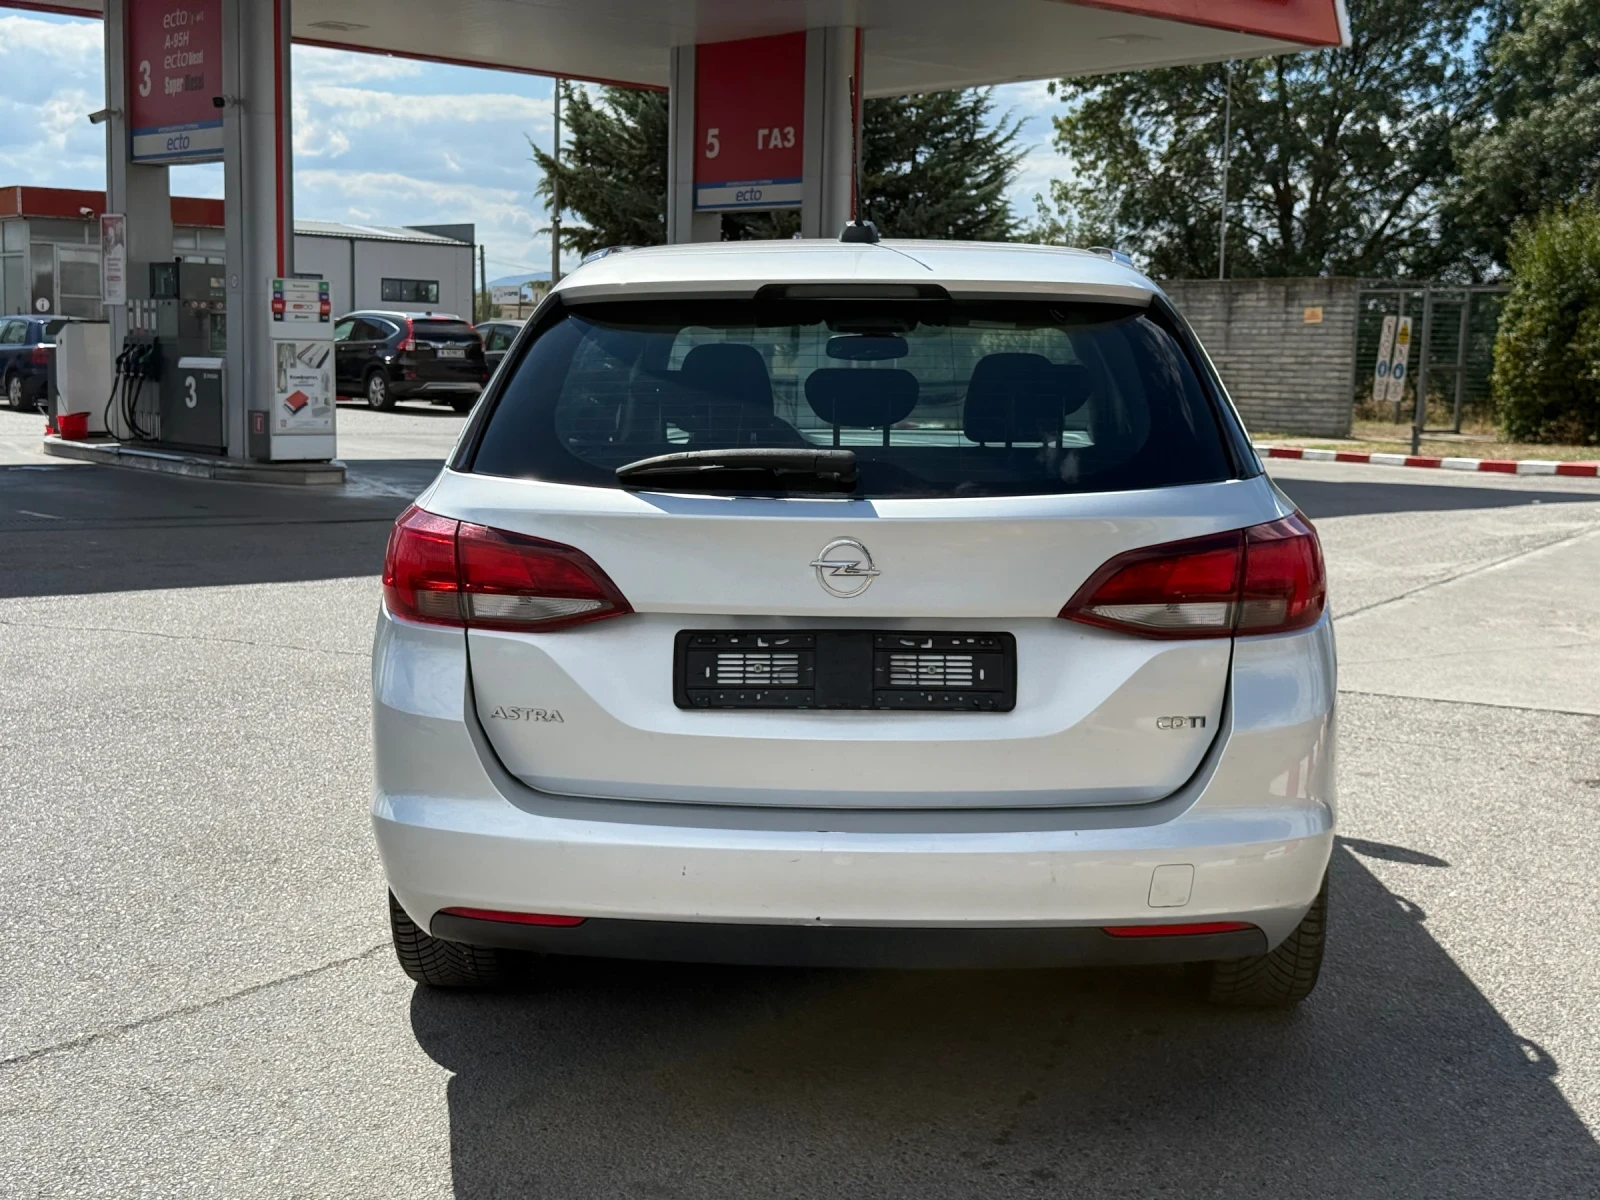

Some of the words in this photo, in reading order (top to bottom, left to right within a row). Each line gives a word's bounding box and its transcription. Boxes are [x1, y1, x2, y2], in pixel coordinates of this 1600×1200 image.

[163, 8, 188, 28] ecto
[138, 59, 152, 97] 3
[164, 75, 184, 97] Super
[166, 133, 190, 151] ecto
[705, 127, 720, 159] 5
[757, 126, 795, 150] ГАЗ
[735, 187, 763, 202] ecto
[185, 375, 198, 409] 3
[490, 706, 565, 723] ASTRA
[1156, 715, 1206, 730] CDTI
